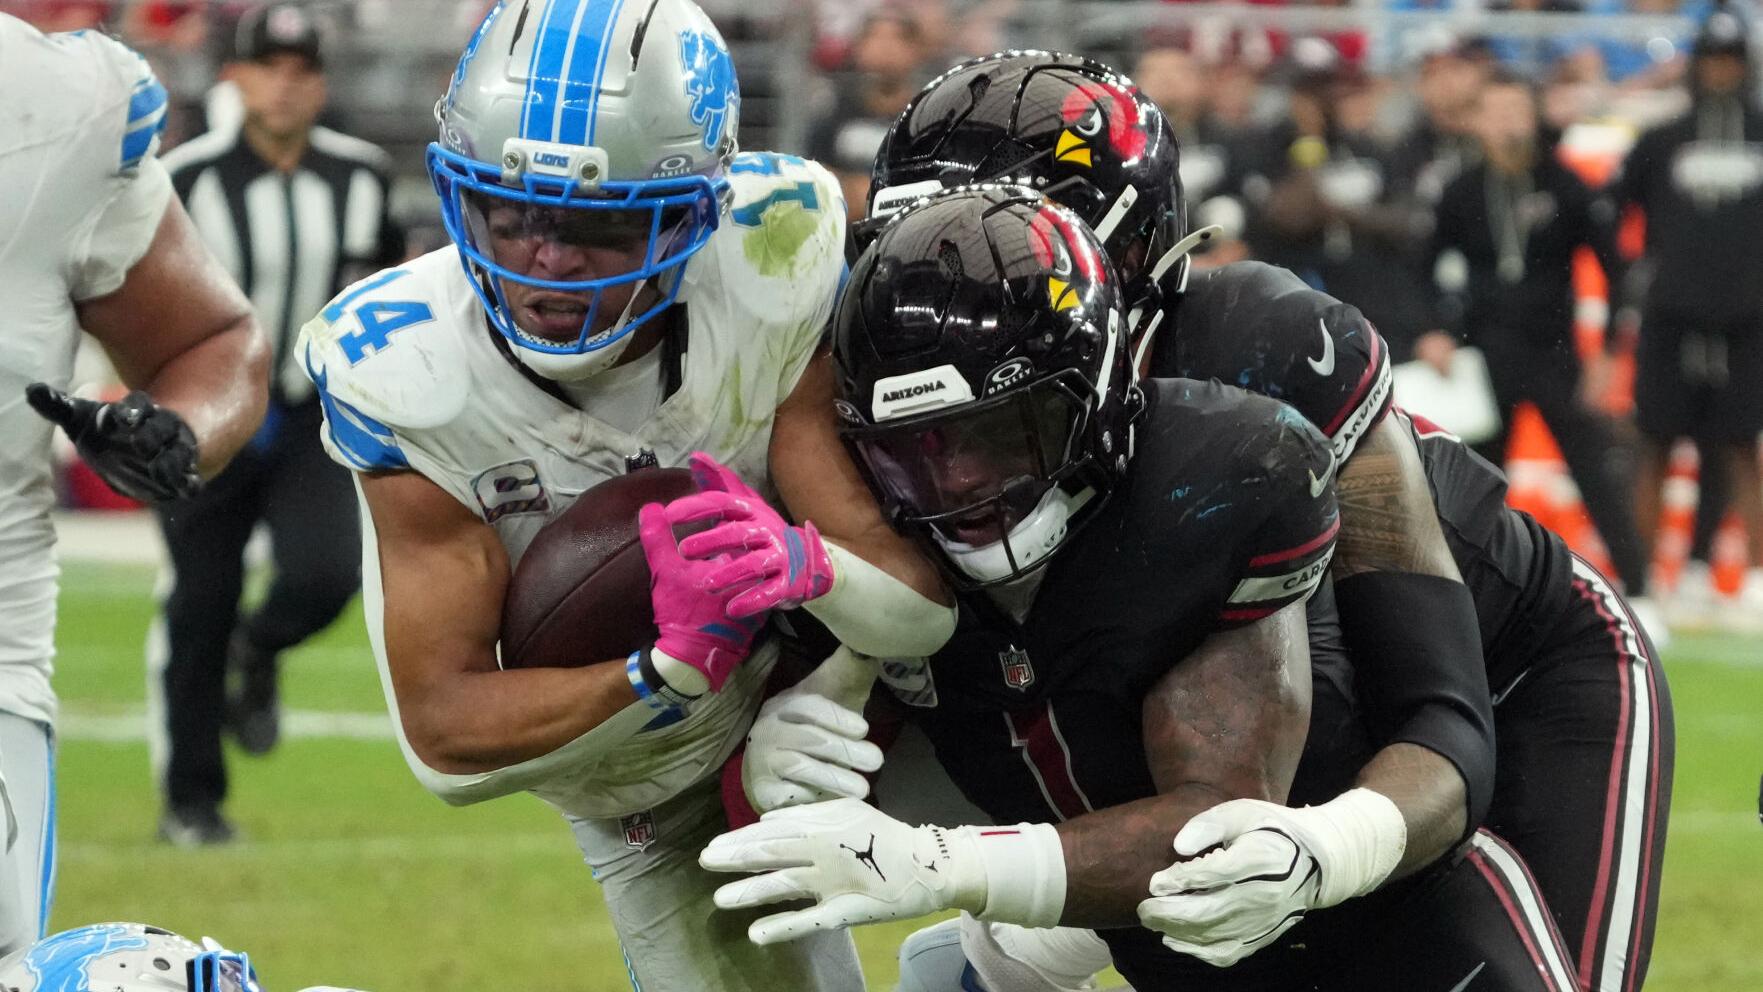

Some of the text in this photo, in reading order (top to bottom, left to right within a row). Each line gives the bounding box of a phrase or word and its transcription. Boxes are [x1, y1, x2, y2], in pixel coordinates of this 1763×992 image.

[321, 268, 438, 369] 14
[882, 380, 946, 402] ARIZONA
[988, 366, 1032, 394] OAKLEY
